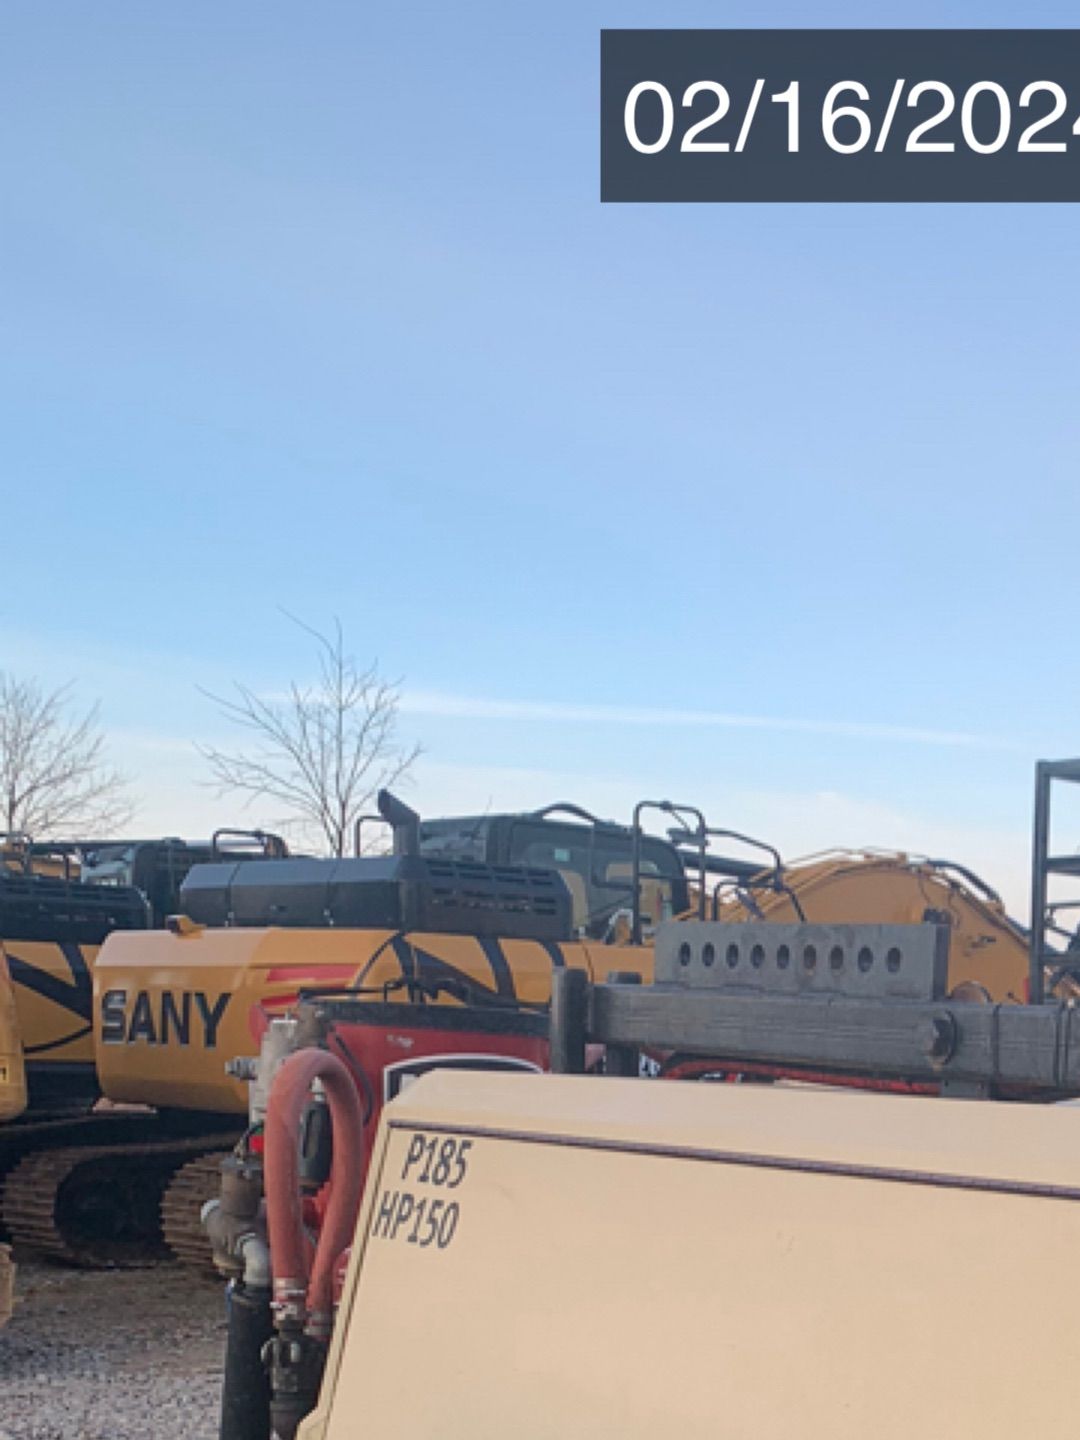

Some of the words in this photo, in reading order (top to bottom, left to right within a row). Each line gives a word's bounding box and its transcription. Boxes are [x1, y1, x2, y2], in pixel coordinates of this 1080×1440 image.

[102, 990, 231, 1046] SANY
[402, 1134, 472, 1188] P185
[372, 1191, 460, 1249] HP150
